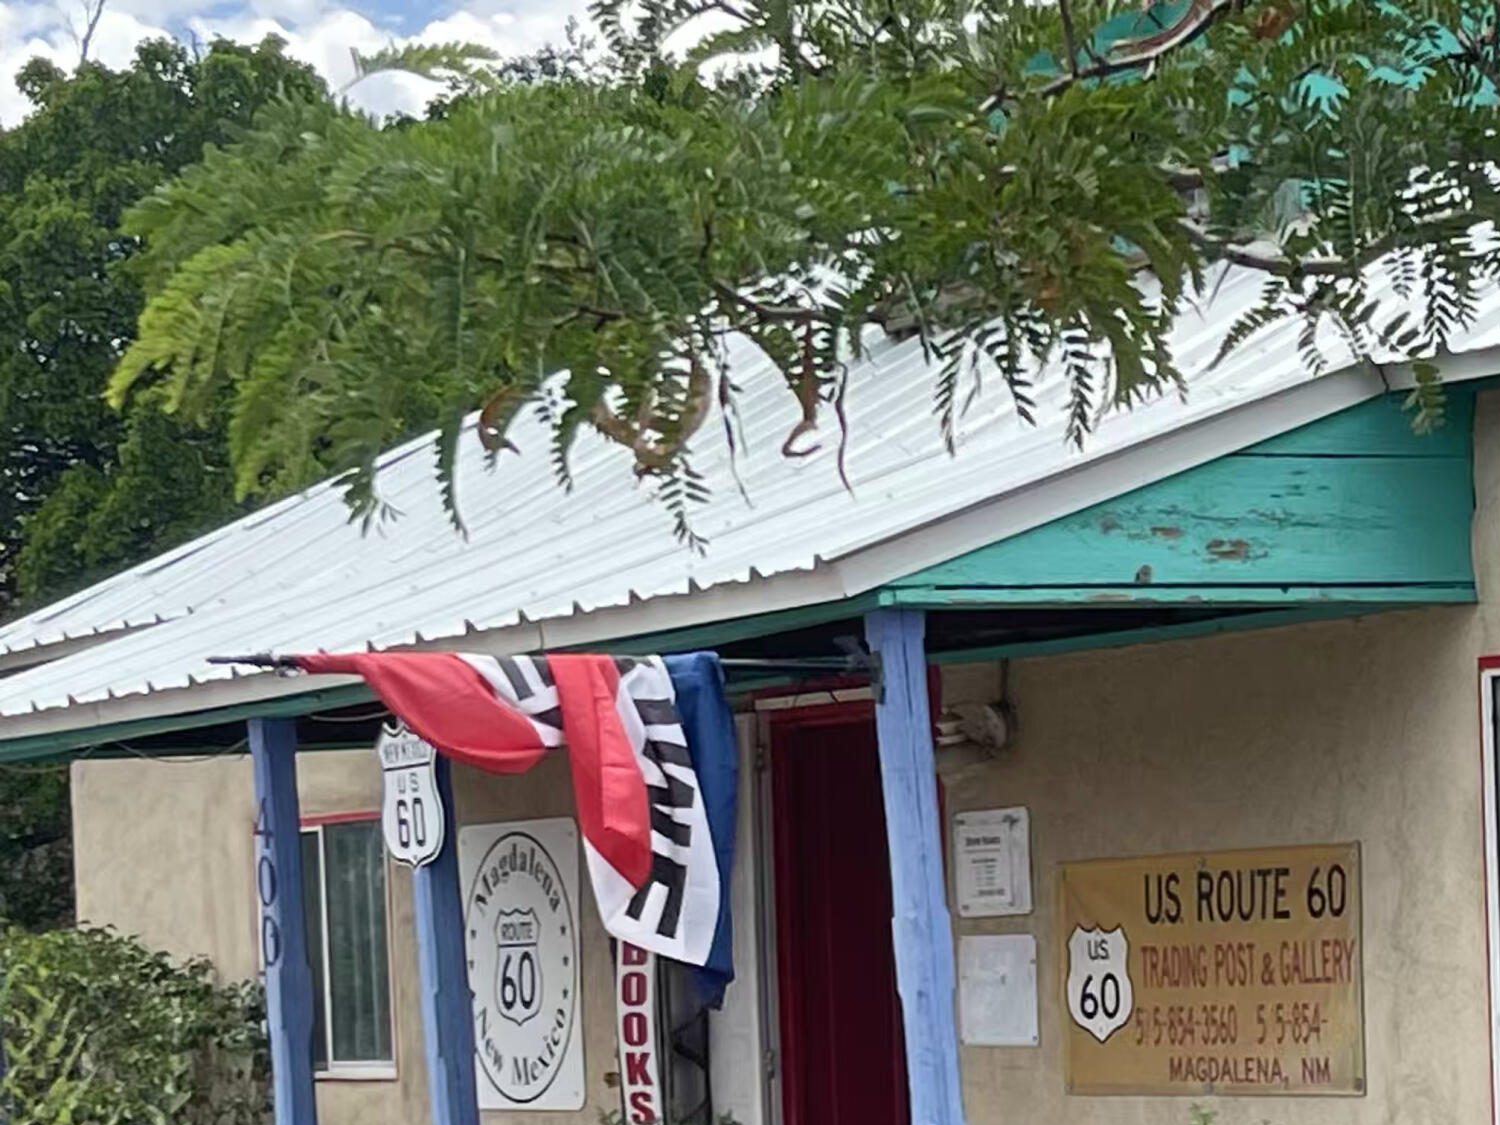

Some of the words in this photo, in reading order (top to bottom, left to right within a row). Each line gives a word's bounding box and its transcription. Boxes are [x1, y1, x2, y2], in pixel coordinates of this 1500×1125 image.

[396, 797, 427, 849] 60
[253, 797, 280, 967] 400
[475, 843, 561, 916] Magdalena
[1197, 868, 1291, 922] ROUTE
[1307, 864, 1347, 919] 60
[502, 921, 533, 940] ROUTE
[502, 951, 535, 1011] 60
[1141, 943, 1208, 988] TRADING
[1214, 942, 1255, 986] POST
[1260, 951, 1276, 987] &
[1279, 938, 1356, 986] GALLERY
[1080, 972, 1121, 1020] 60
[476, 1007, 503, 1073] New
[511, 1008, 566, 1086] Mexico
[1169, 1056, 1289, 1090] MAGDALENA,
[1301, 1056, 1332, 1084] NM
